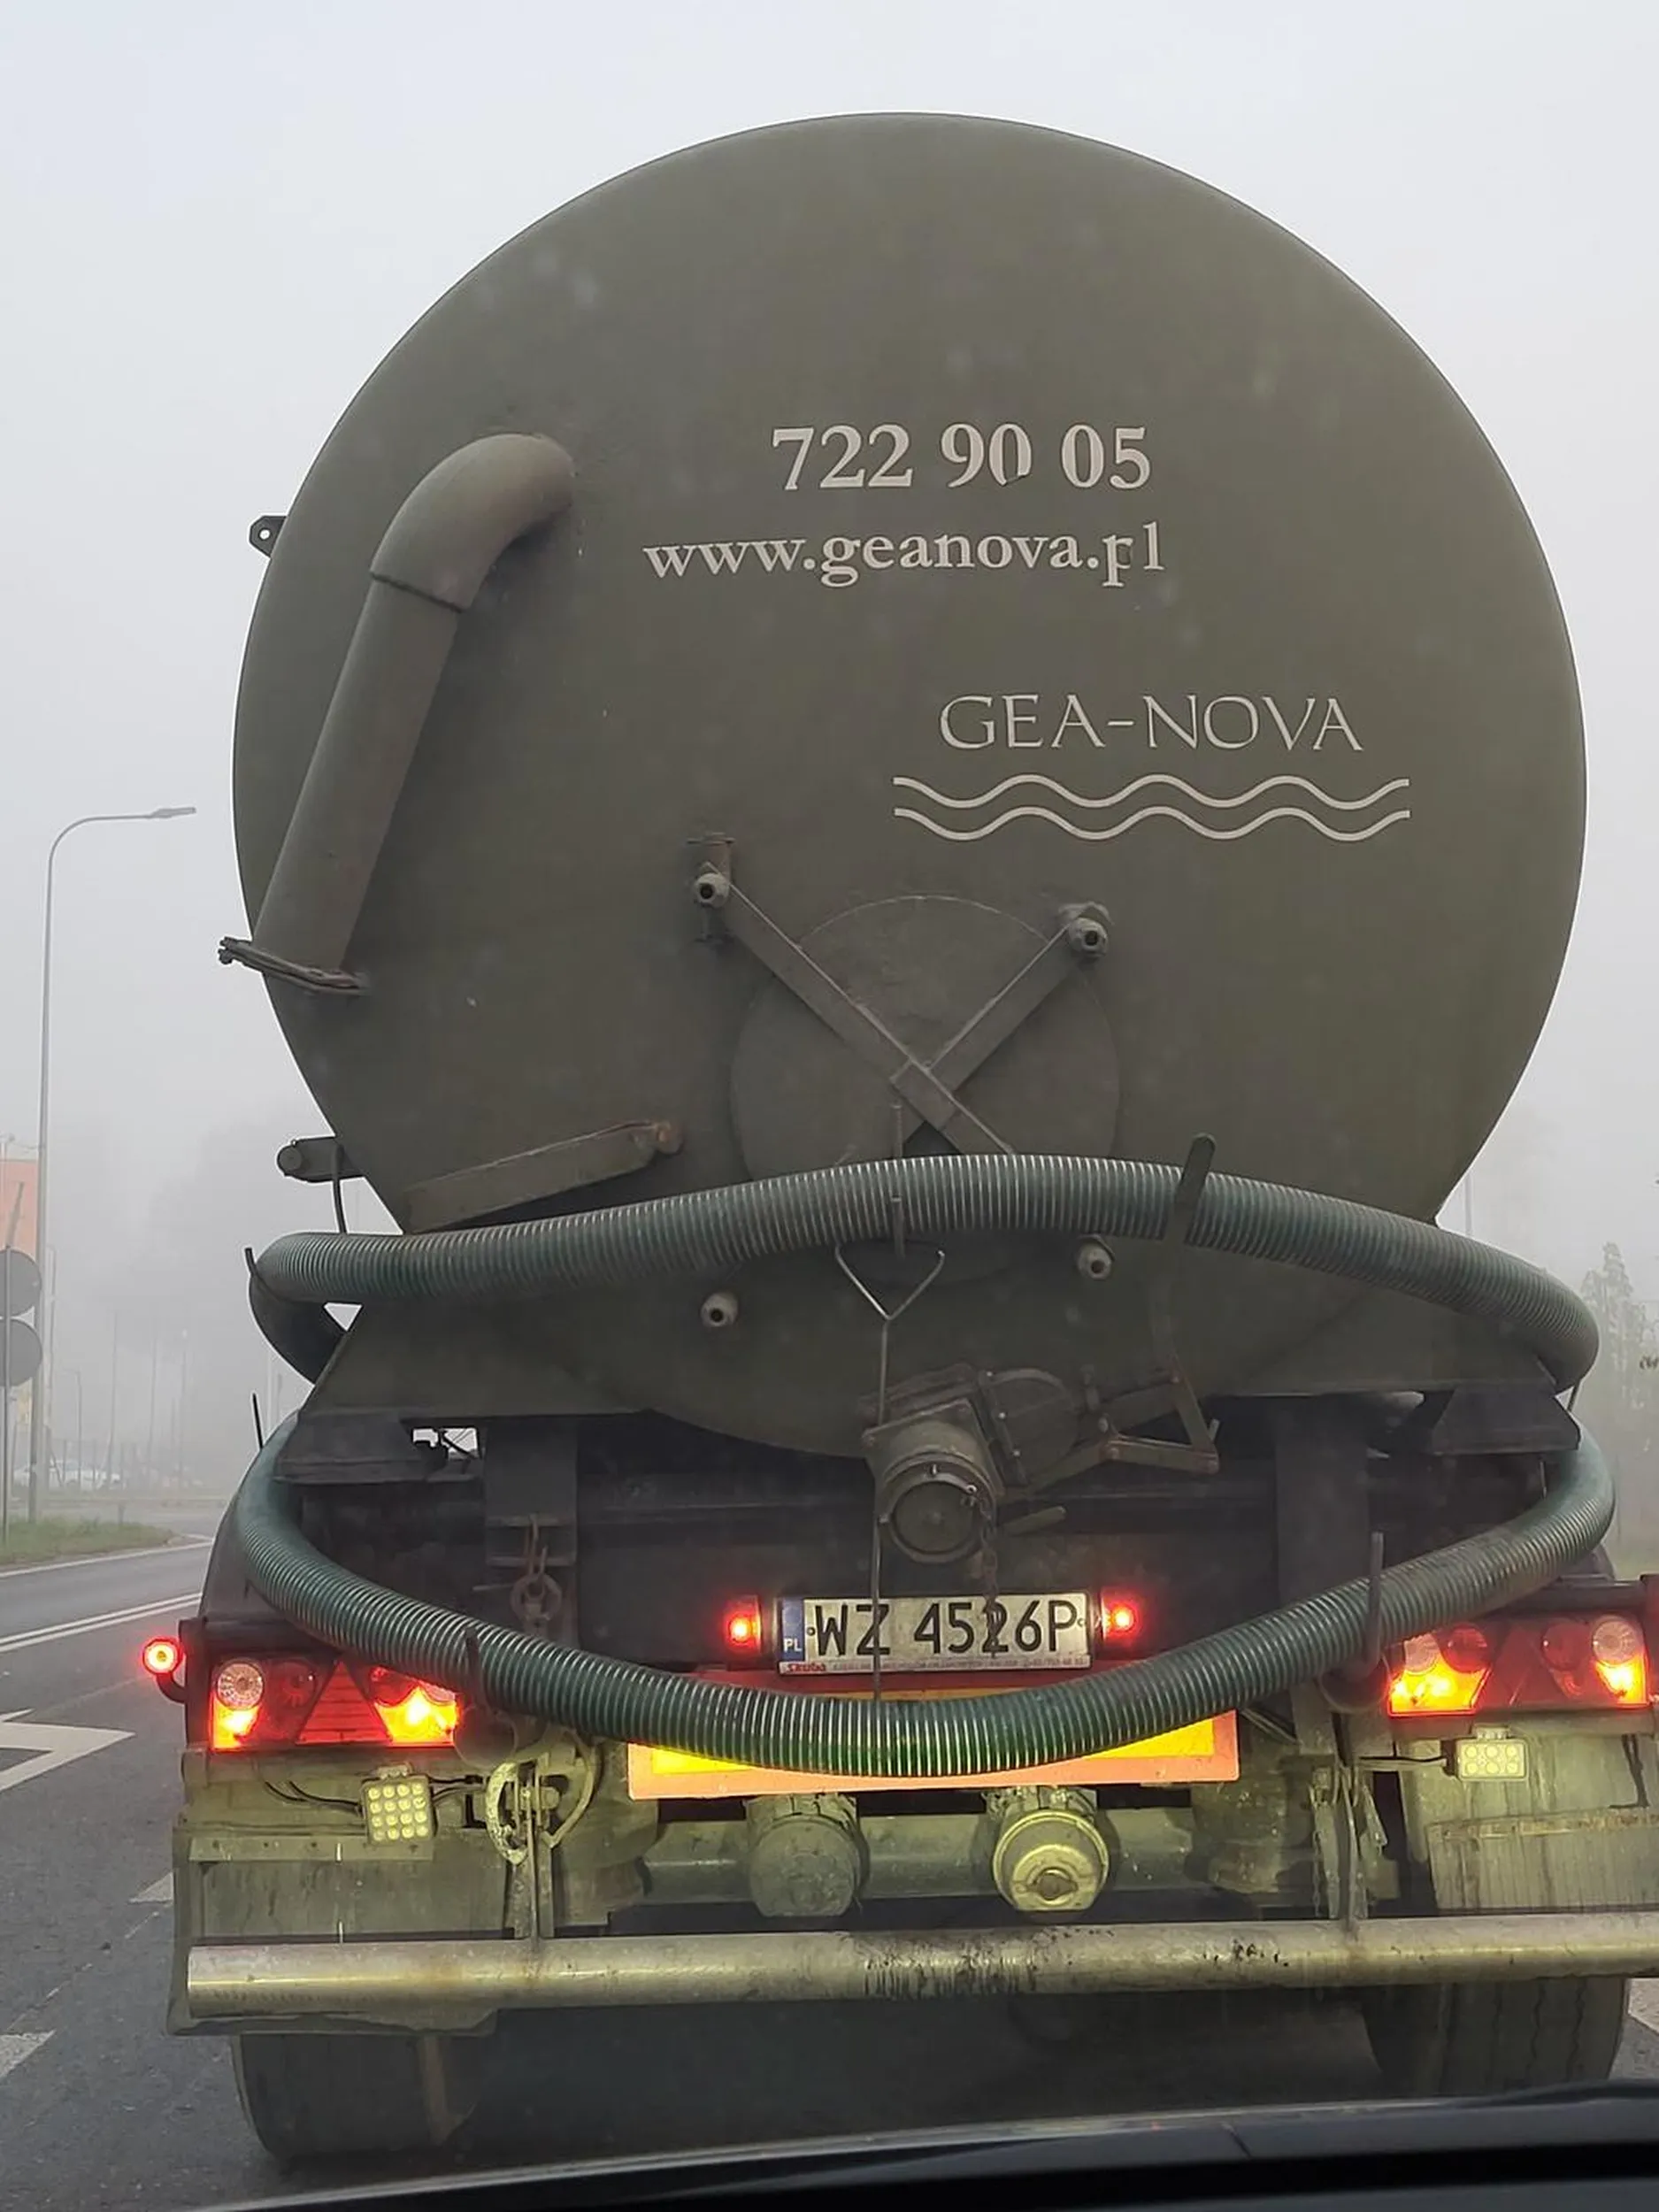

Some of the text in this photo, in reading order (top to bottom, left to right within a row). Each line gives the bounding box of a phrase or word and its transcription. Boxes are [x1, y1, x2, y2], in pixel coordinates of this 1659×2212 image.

[772, 423, 1151, 490] 722 90 05
[643, 521, 1165, 588] www.geanova.pl
[940, 694, 1363, 751] GEA-NOVA
[784, 1638, 803, 1653] PL
[815, 1600, 1078, 1655] WZ 4526P
